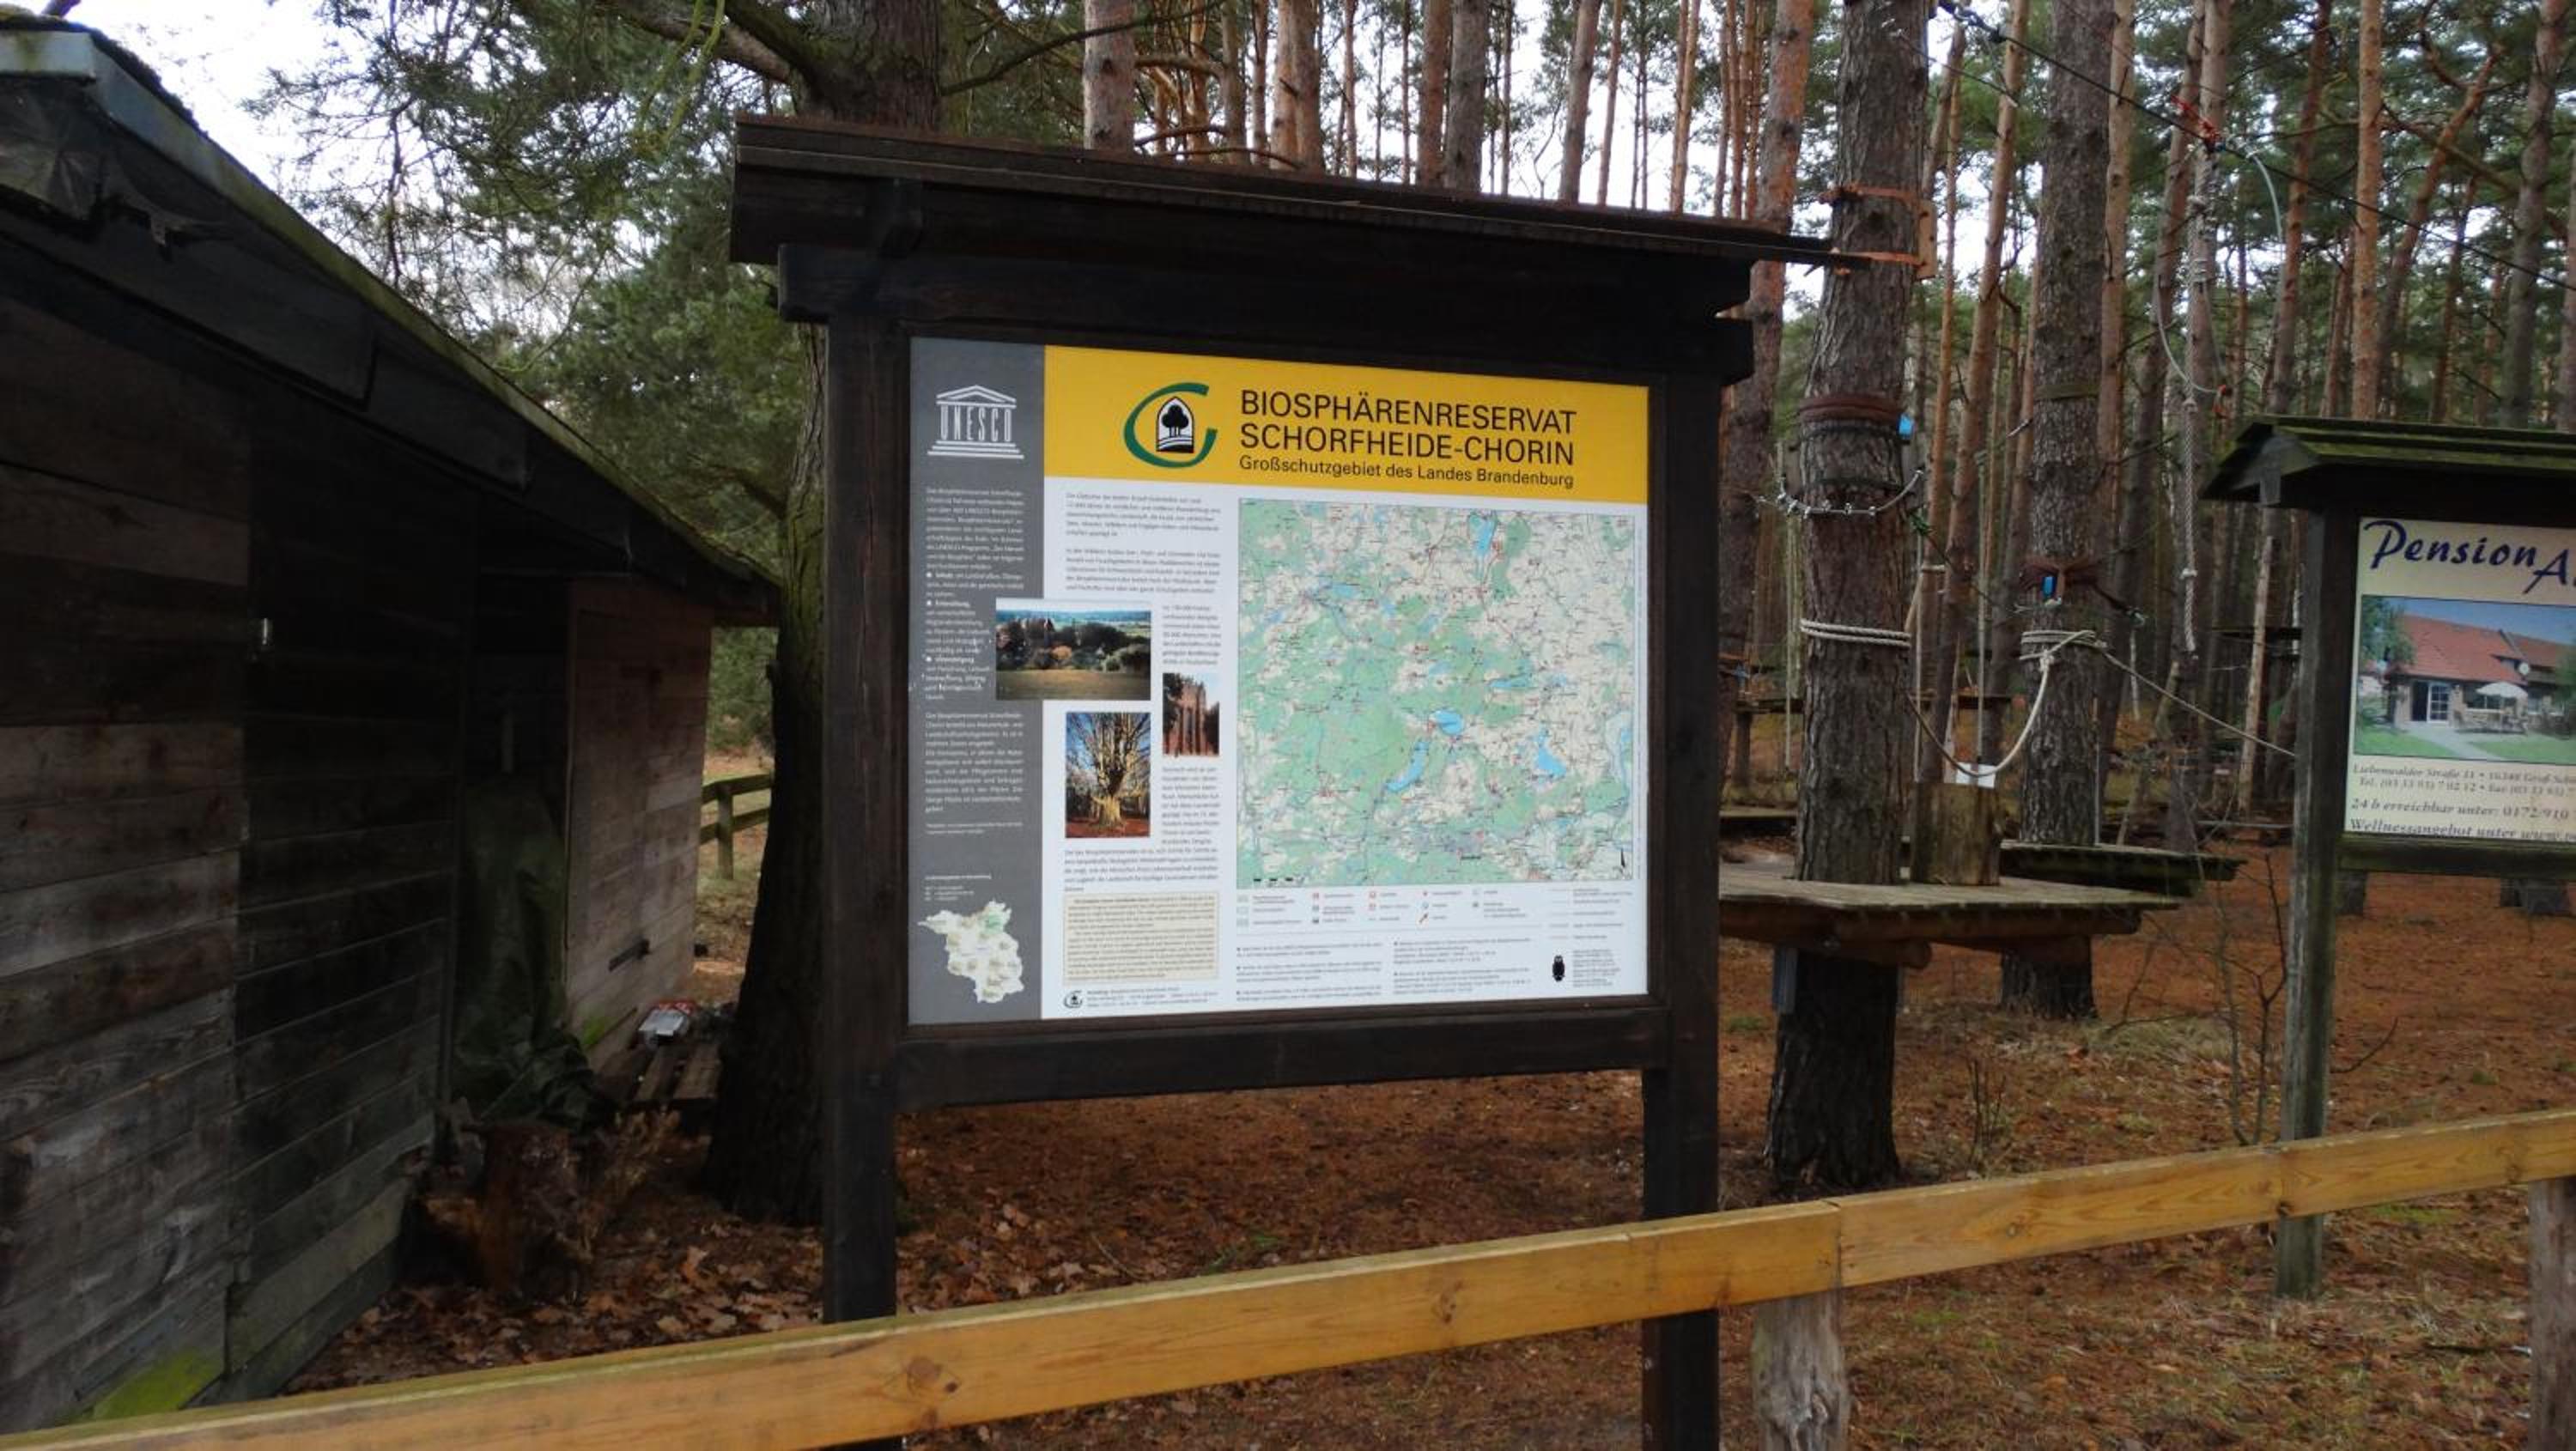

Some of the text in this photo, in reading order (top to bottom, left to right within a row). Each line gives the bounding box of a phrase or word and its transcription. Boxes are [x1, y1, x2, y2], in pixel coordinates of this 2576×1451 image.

[940, 404, 1012, 442] UNESCO
[1241, 389, 1577, 434] BIOSPHÄRENRESERVAT
[1240, 422, 1574, 466] SCHORFHEIDE-CHORIN
[1239, 454, 1574, 489] Großschutzgebiet des Landes Brandenburg
[2363, 519, 2576, 594] Pension A
